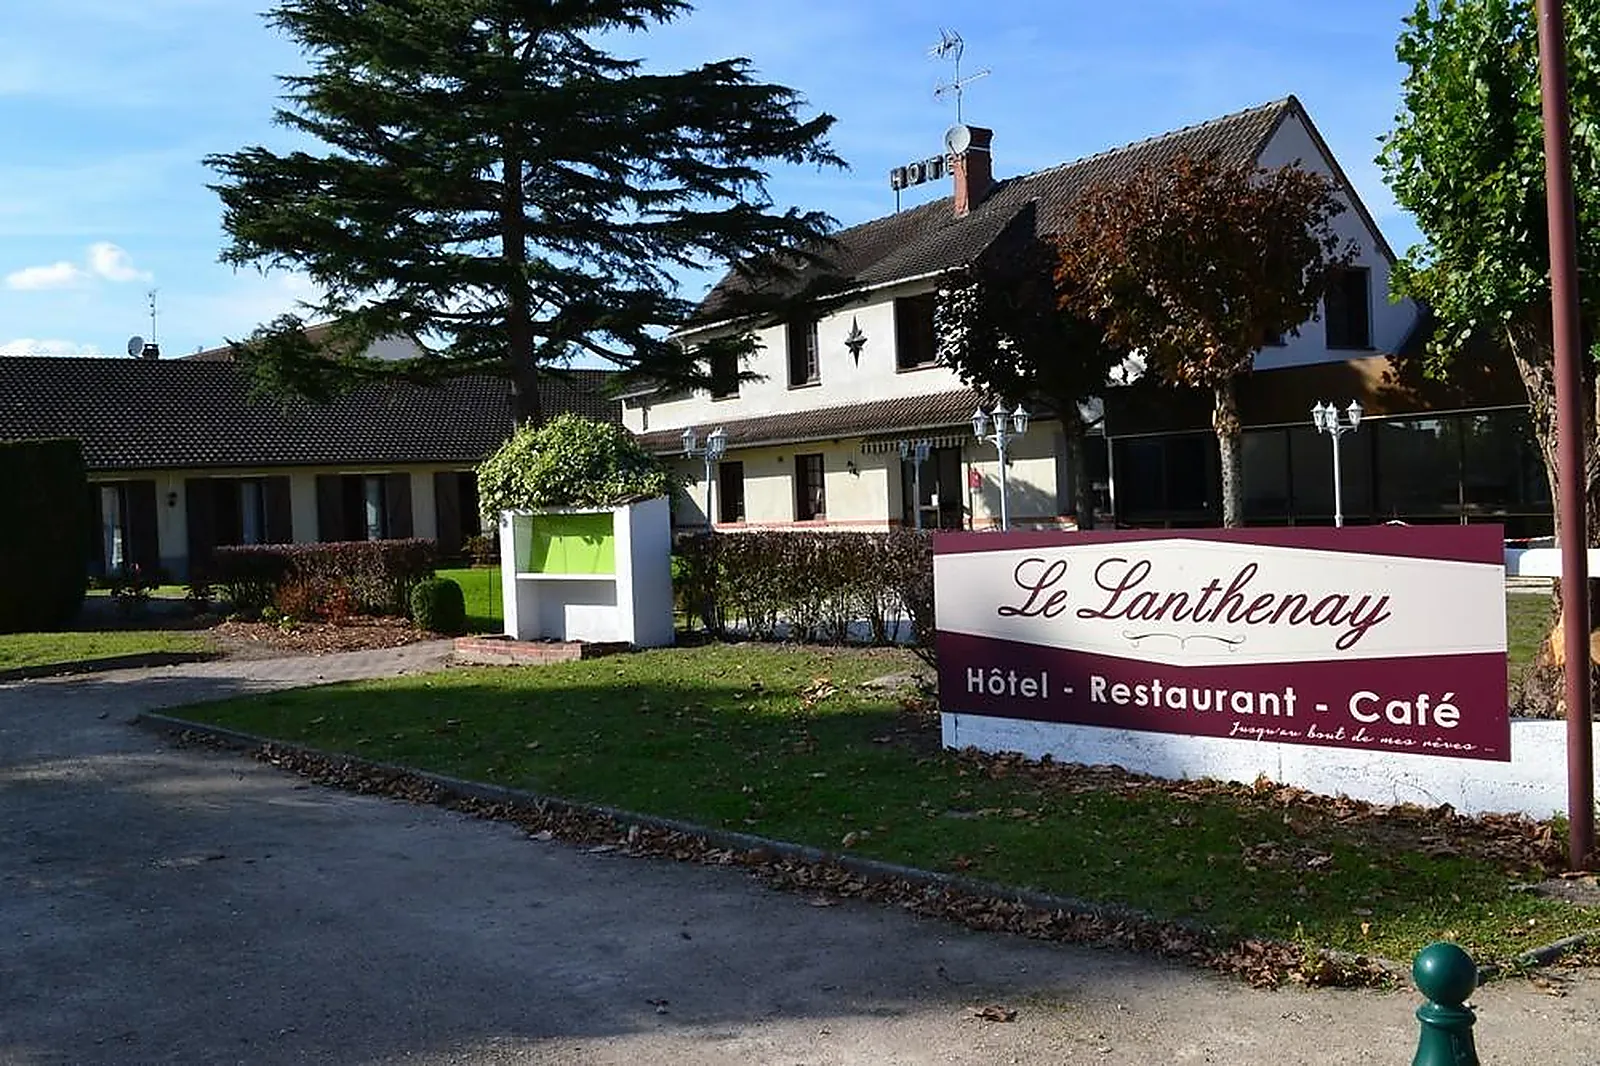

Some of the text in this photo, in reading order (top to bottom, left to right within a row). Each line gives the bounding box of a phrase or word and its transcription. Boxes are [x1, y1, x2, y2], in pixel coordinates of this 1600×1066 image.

[890, 151, 956, 191] HOTE
[998, 558, 1391, 651] Le Lanthenay
[967, 667, 1049, 699] Hôtel
[1090, 676, 1297, 717] Restaurant
[1349, 690, 1461, 728] Café
[1307, 723, 1346, 740] bout
[1351, 727, 1375, 743] de
[1380, 737, 1417, 746] mes
